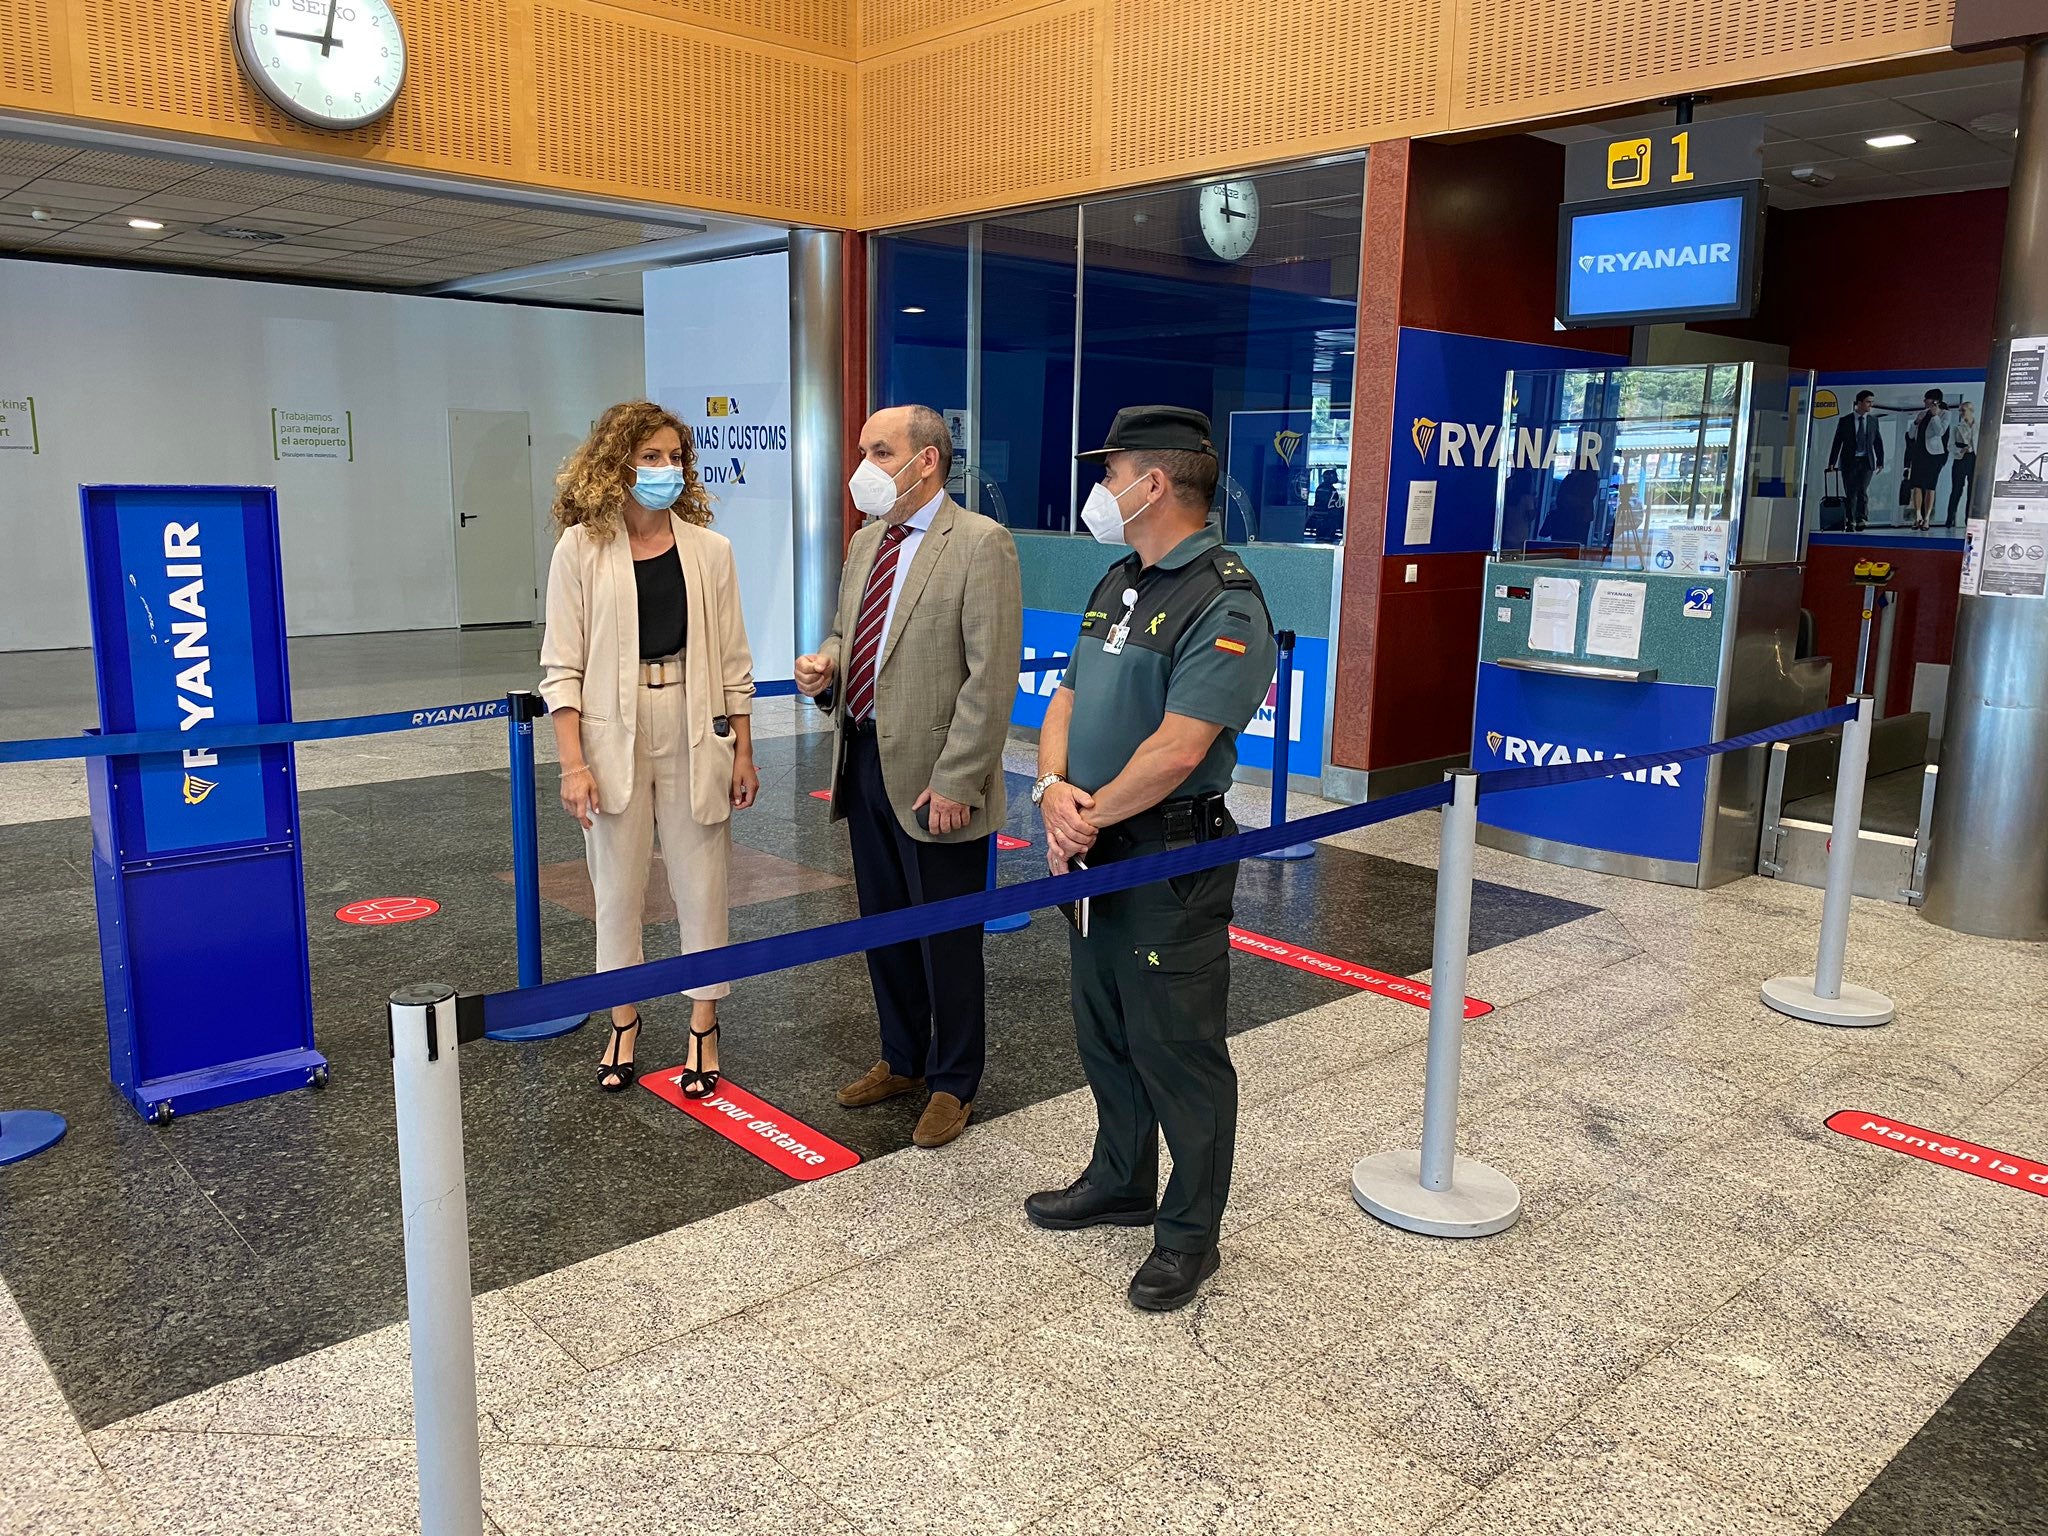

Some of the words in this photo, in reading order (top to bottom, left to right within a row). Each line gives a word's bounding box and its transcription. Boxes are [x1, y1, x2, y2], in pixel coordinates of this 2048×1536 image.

[292, 0, 356, 22] SEIKO
[371, 16, 380, 27] 2
[259, 24, 268, 36] 9
[380, 46, 389, 58] 3
[272, 57, 281, 69] 8
[374, 75, 382, 87] 4
[295, 82, 303, 94] 7
[325, 95, 333, 106] 6
[354, 92, 362, 104] 5
[1671, 132, 1694, 184] 1
[1597, 243, 1731, 274] RYANAIR
[280, 411, 333, 423] Trabajamos
[280, 425, 301, 434] para
[303, 425, 340, 436] mejorar
[281, 436, 291, 445] el
[293, 437, 346, 447] aeropuerto
[692, 425, 719, 450] ANAS
[728, 425, 786, 450] CUSTOMS
[411, 703, 498, 726] RYANAIR
[1228, 932, 1289, 956] stancia
[1297, 953, 1342, 972] Keep
[1340, 970, 1388, 987] your
[702, 1097, 755, 1121] your
[747, 1119, 826, 1166] distance
[1860, 1121, 1981, 1164] Mantén
[1988, 1159, 2019, 1175] la
